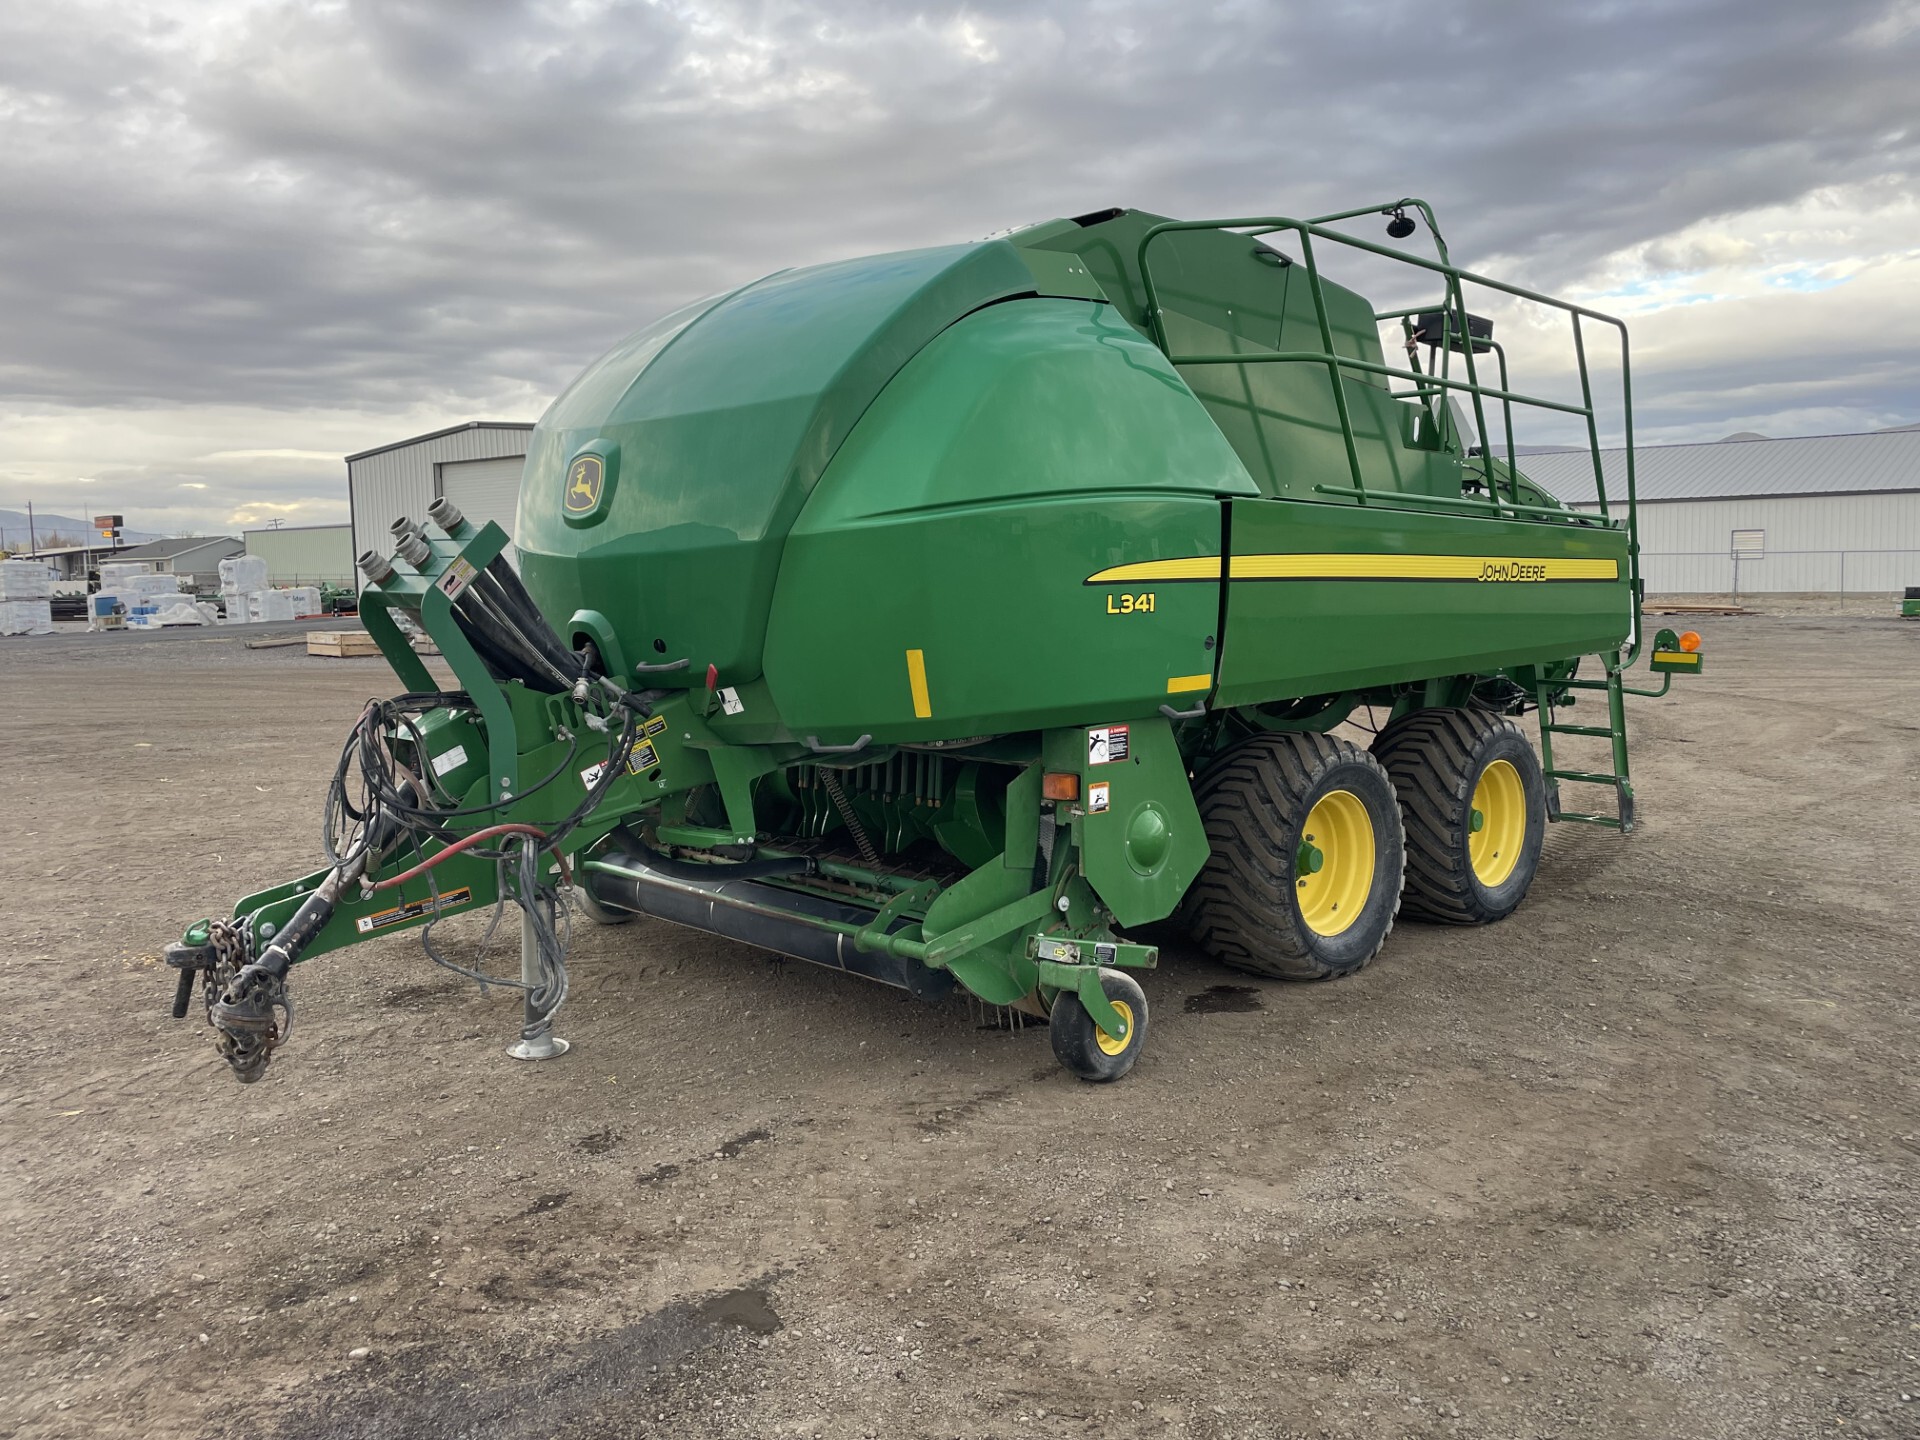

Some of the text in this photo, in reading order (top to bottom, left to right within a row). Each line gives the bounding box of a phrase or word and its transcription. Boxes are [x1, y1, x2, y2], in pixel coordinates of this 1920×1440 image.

[1478, 562, 1546, 580] JOHN DEERE
[1107, 593, 1155, 614] L341
